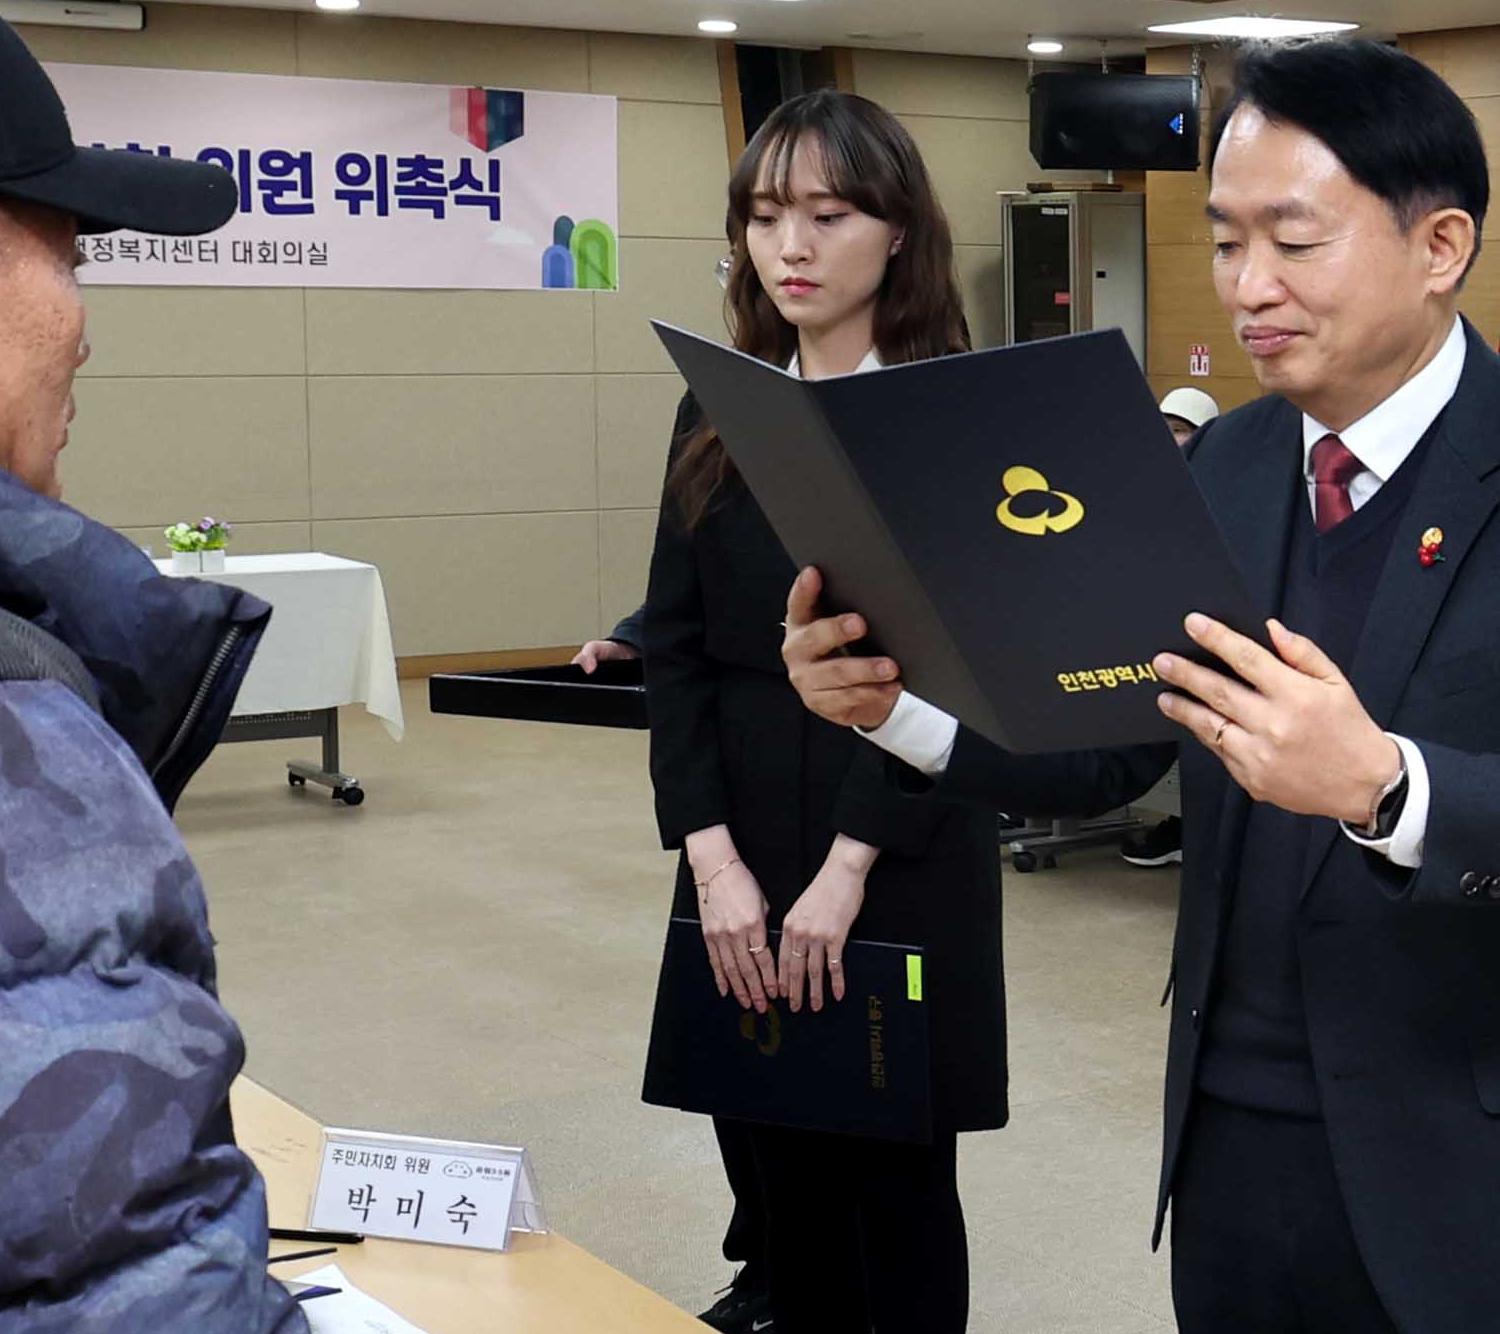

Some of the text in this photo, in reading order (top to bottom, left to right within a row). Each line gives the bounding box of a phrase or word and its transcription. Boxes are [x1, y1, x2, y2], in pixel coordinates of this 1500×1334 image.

[334, 152, 501, 221] 위촉식
[232, 240, 328, 266] 대회의실
[1057, 662, 1158, 693] 인천광역시
[331, 1148, 431, 1175] 주민자치회 위원
